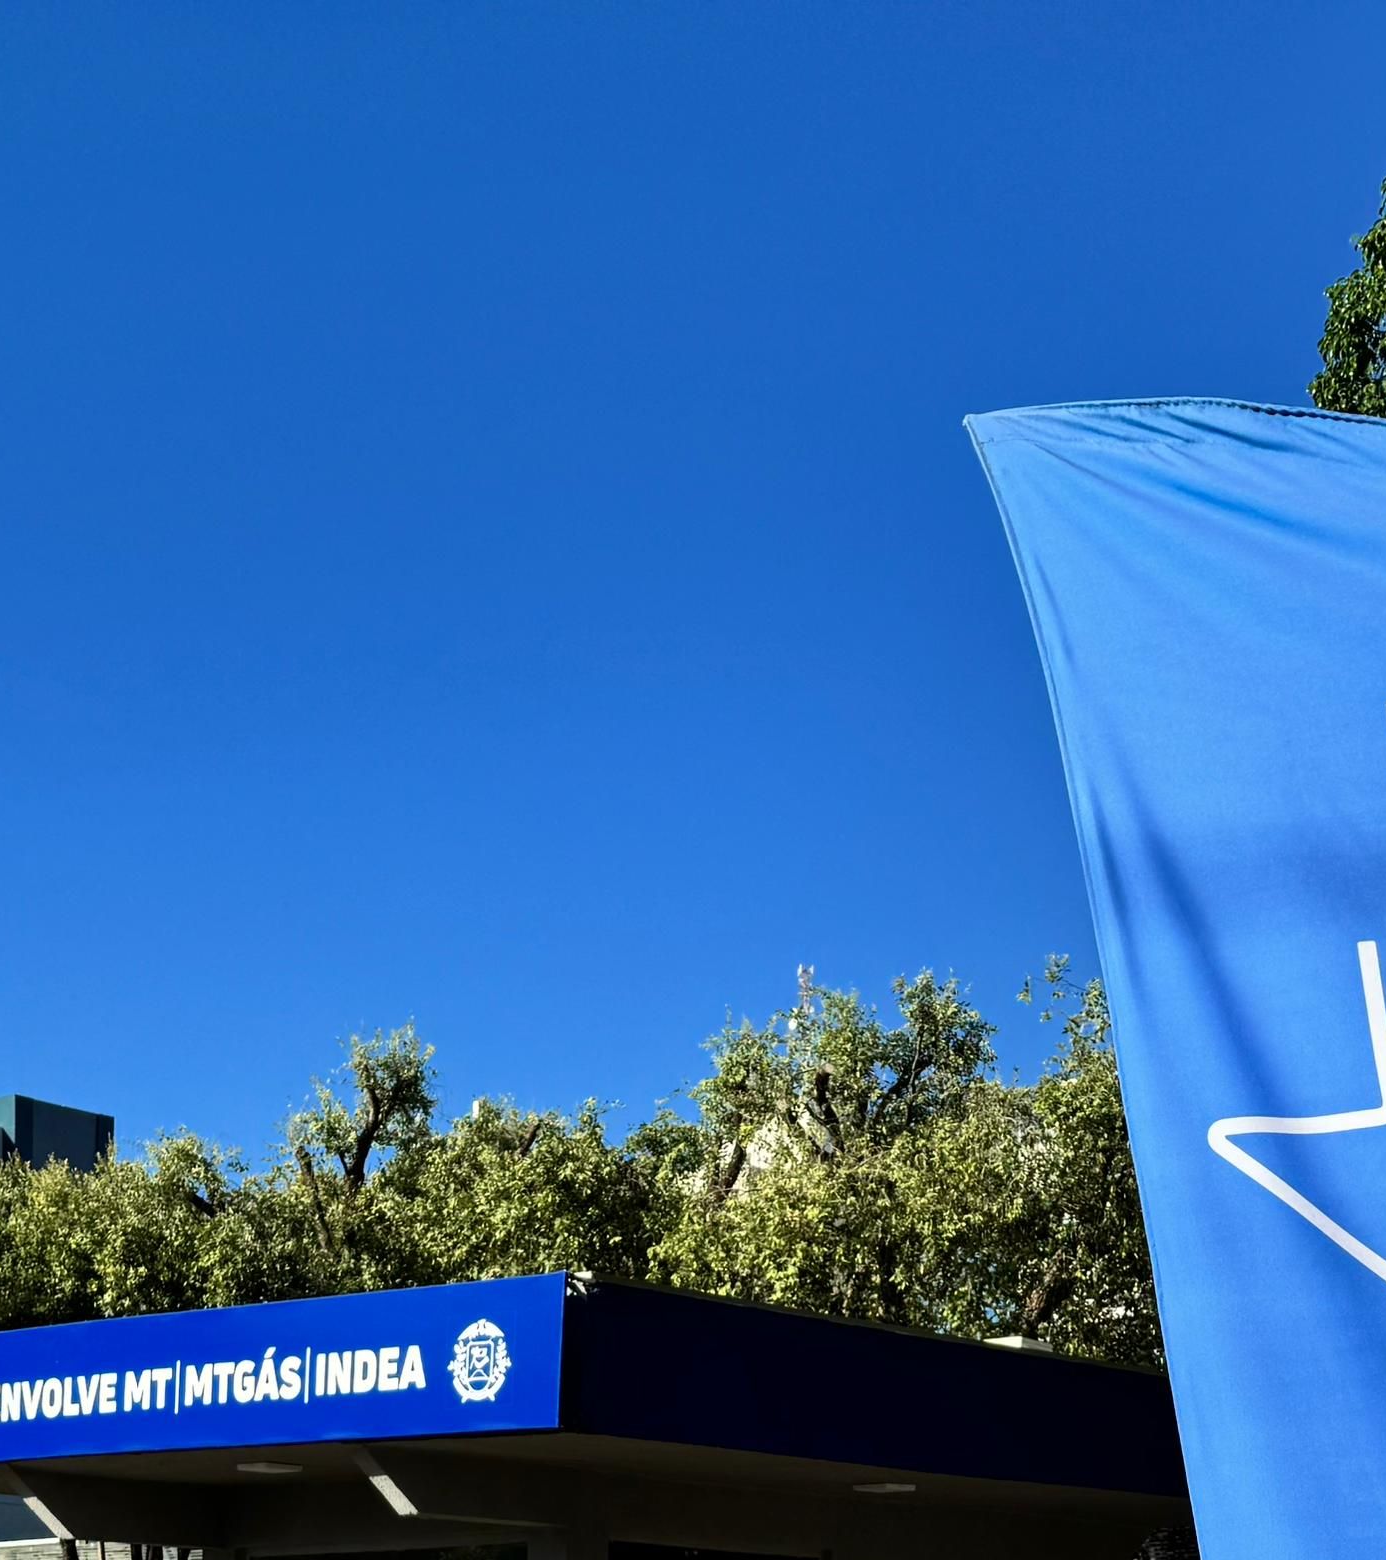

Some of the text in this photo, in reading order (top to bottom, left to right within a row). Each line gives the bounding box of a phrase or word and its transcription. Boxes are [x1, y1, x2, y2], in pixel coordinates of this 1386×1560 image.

[123, 1367, 173, 1412] MT
[184, 1346, 302, 1407] MTGÁS
[314, 1344, 427, 1397] INDEA
